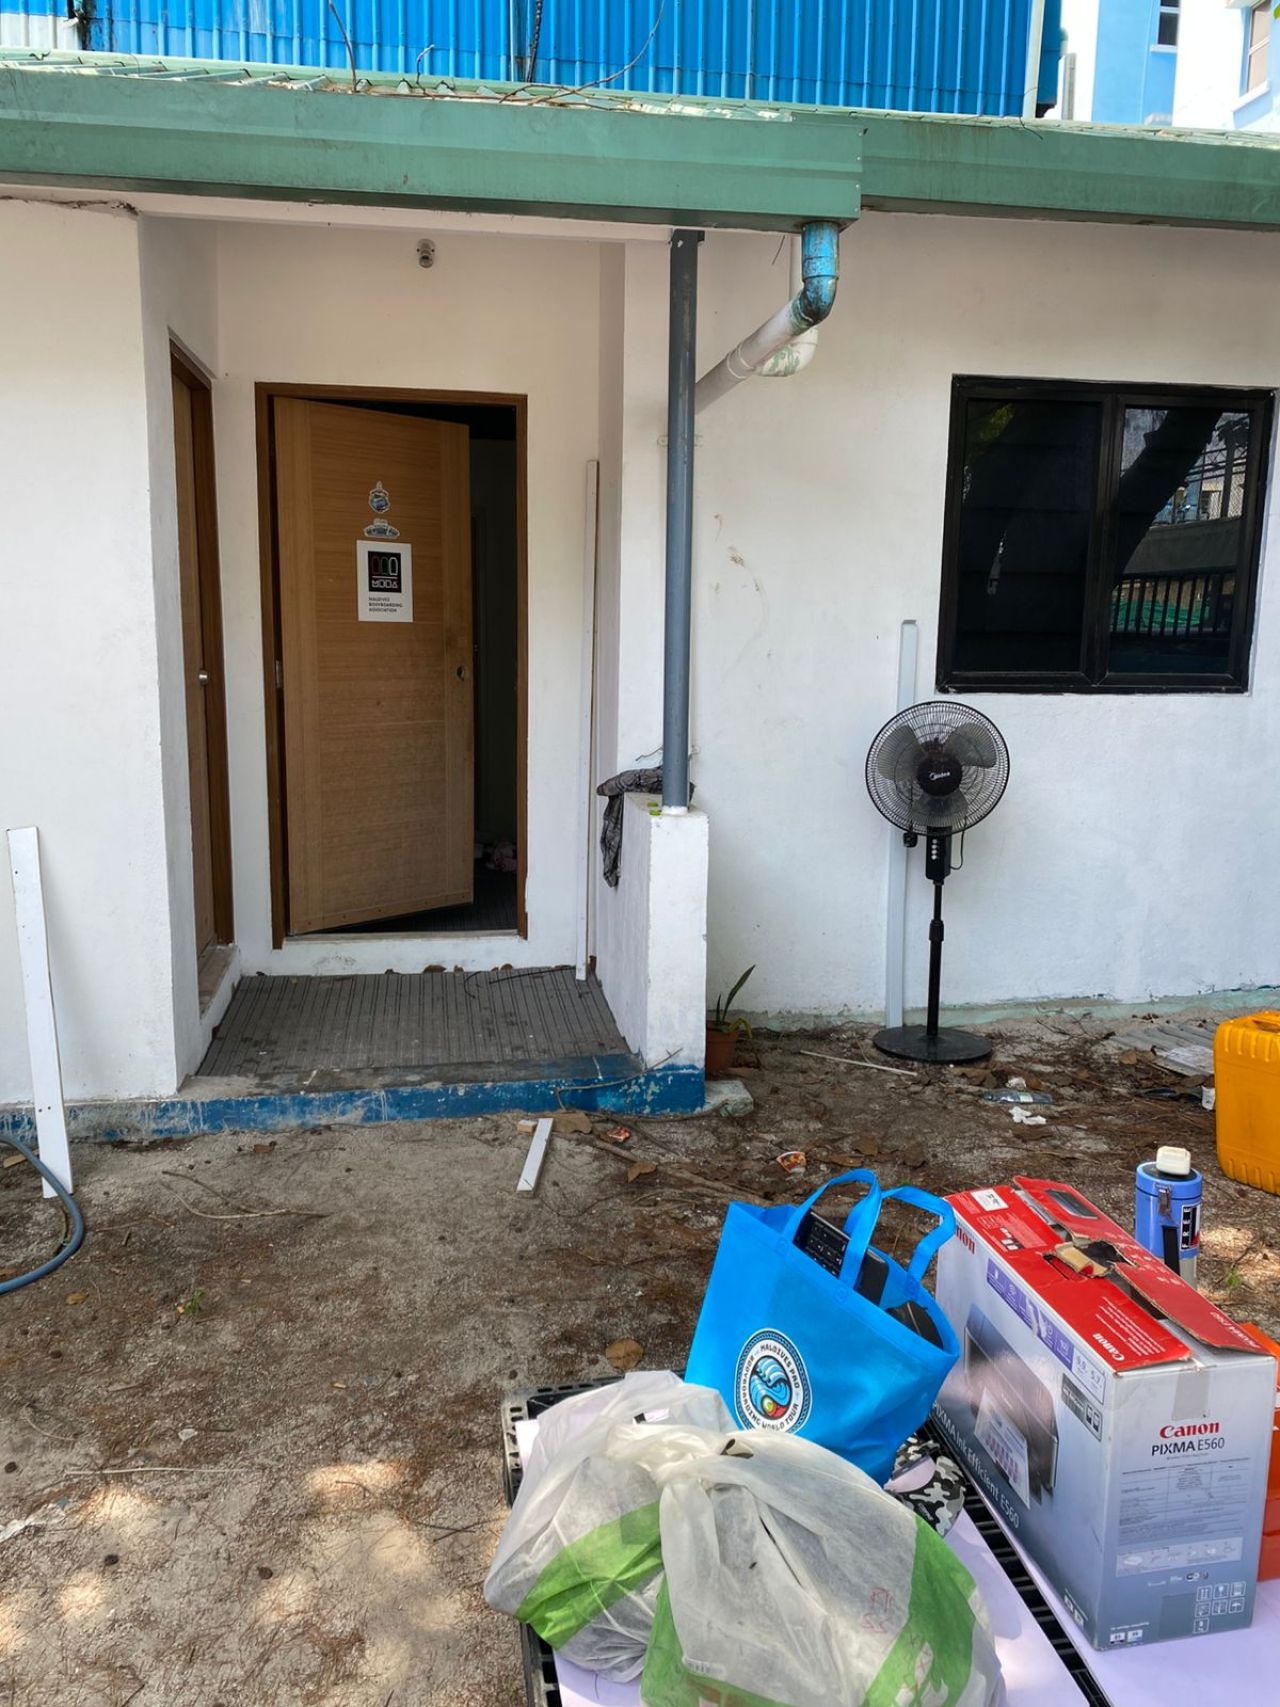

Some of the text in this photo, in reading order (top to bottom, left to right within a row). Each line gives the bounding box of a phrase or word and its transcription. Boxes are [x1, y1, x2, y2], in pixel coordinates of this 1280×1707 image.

[956, 1224, 975, 1254] non
[1093, 1333, 1125, 1360] Canon
[760, 1343, 800, 1389] MALDIVES PRO
[741, 1355, 761, 1426] BODYBOARDING
[785, 1403, 799, 1424] TOUR
[1160, 1422, 1220, 1439] Canon
[1151, 1437, 1225, 1456] PIXMA E560
[967, 1447, 999, 1501] Efficient
[1001, 1494, 1020, 1529] E560
